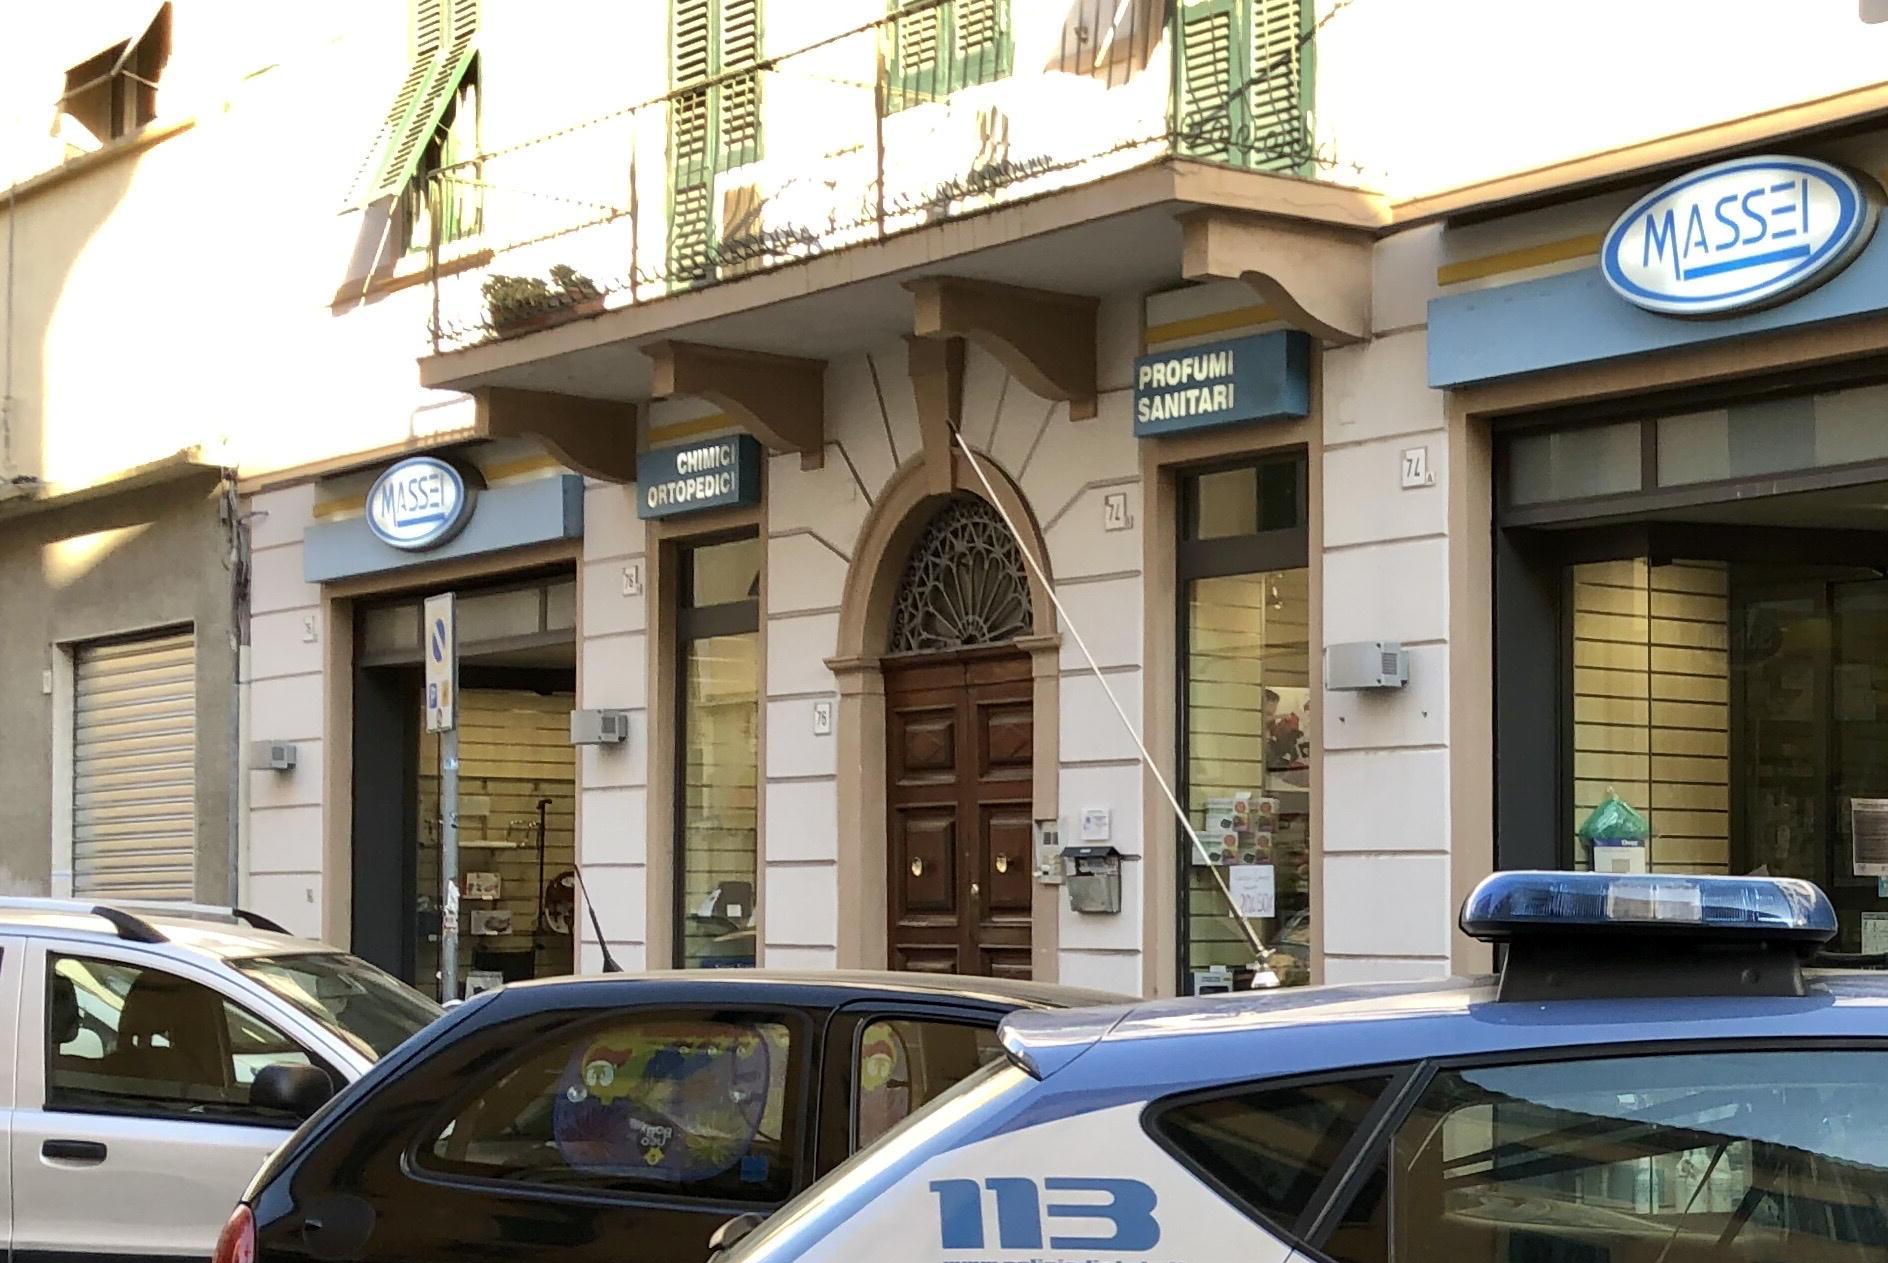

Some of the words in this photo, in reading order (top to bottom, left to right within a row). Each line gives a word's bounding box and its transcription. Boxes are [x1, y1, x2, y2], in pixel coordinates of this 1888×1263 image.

[1642, 178, 1809, 281] MASSEI
[1138, 350, 1234, 392] PROFUMI
[1137, 383, 1235, 423] SANITARI
[676, 444, 736, 475] CHIMICI
[380, 473, 445, 527] MASSEI
[647, 471, 736, 508] ORTOPEDICI
[929, 1177, 1161, 1252] 113
